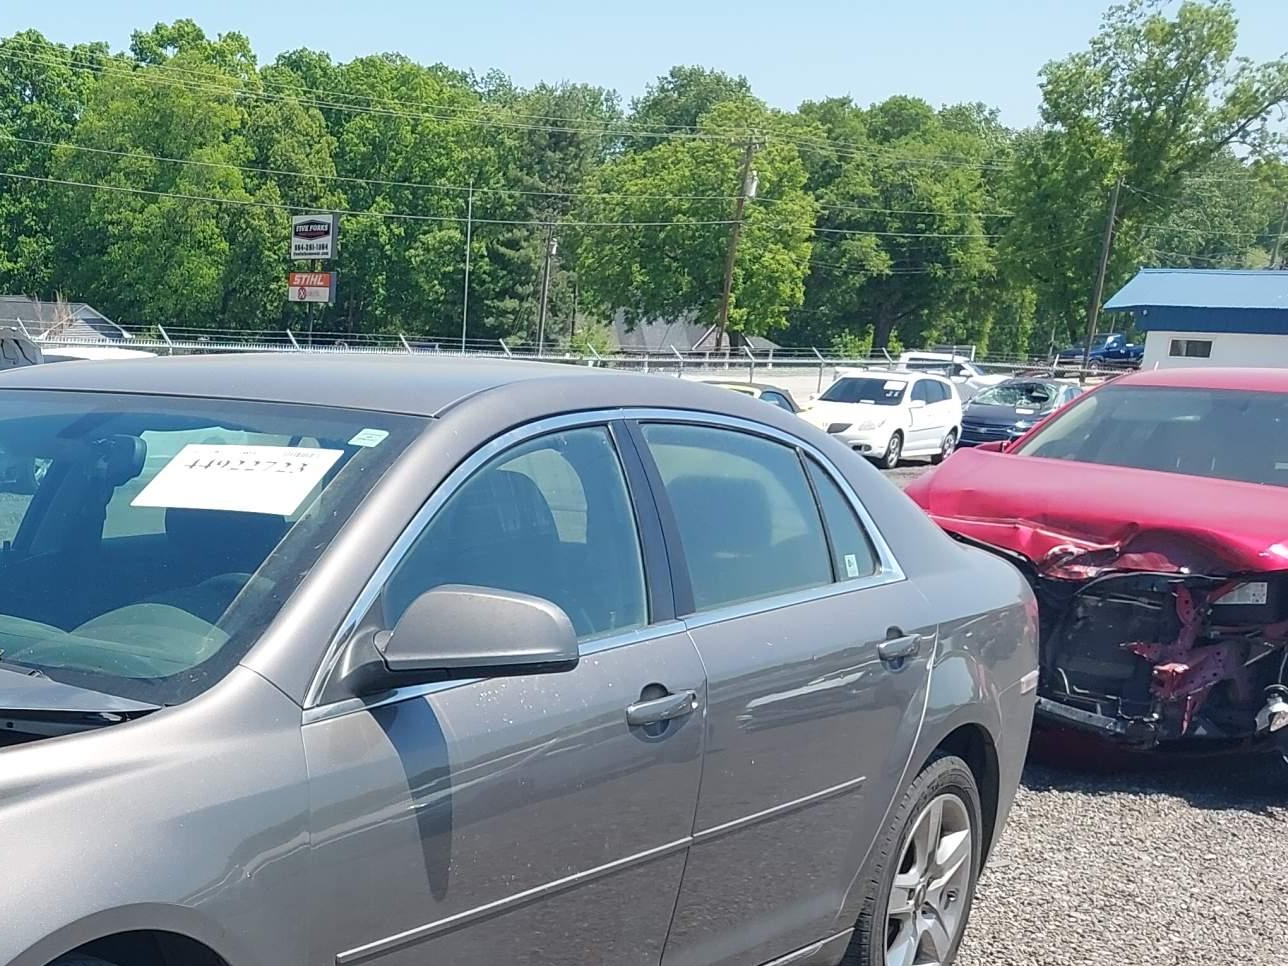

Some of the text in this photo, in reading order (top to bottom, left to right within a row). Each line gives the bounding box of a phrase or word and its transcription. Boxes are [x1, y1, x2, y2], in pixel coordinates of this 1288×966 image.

[309, 224, 328, 232] FORKS
[293, 273, 324, 285] STIHL
[184, 458, 308, 473] 44922723
